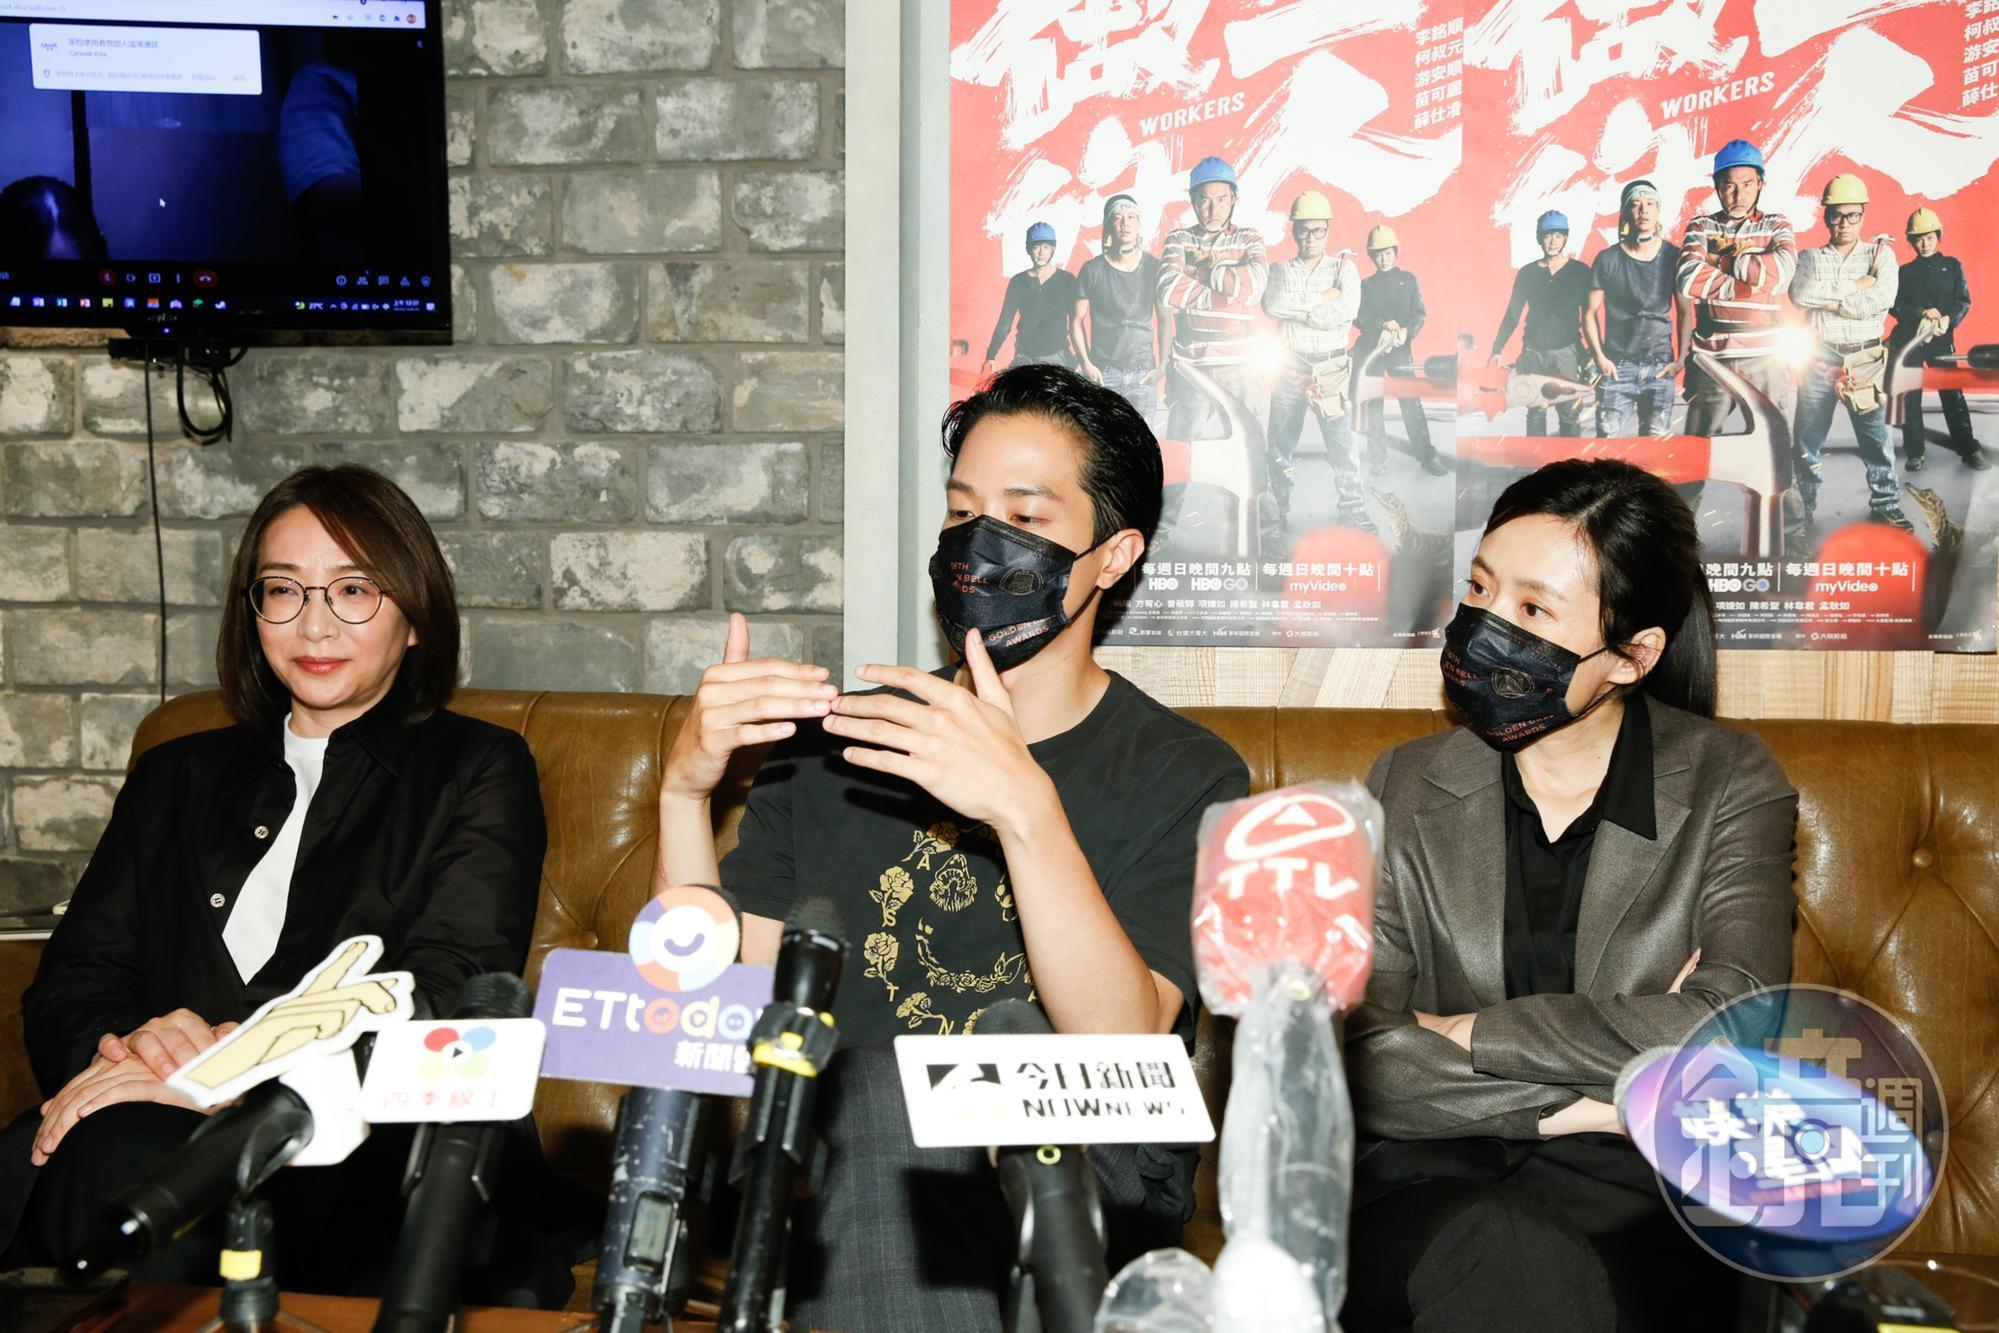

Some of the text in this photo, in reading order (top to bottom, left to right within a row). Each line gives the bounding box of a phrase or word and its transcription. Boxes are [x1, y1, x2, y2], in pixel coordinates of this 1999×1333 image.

[1416, 17, 1464, 46] 李銘順
[1415, 39, 1463, 67] 柯叔元
[1415, 58, 1462, 88] 游安順
[1660, 72, 1775, 119] WORKERS
[1140, 93, 1245, 136] WORKERS
[1142, 562, 1375, 577] 每週日晚間九點 每週日晚間十點
[1786, 562, 1909, 577] 每週日晚間十點
[1148, 578, 1179, 591] HBO
[1290, 580, 1347, 594] myVideo
[1815, 580, 1879, 593] myVideo
[989, 621, 1031, 642] GOLDEN
[1006, 625, 1050, 647] AWARDS
[552, 987, 763, 1039] ETtoda
[1016, 1061, 1176, 1090] 今日新聞
